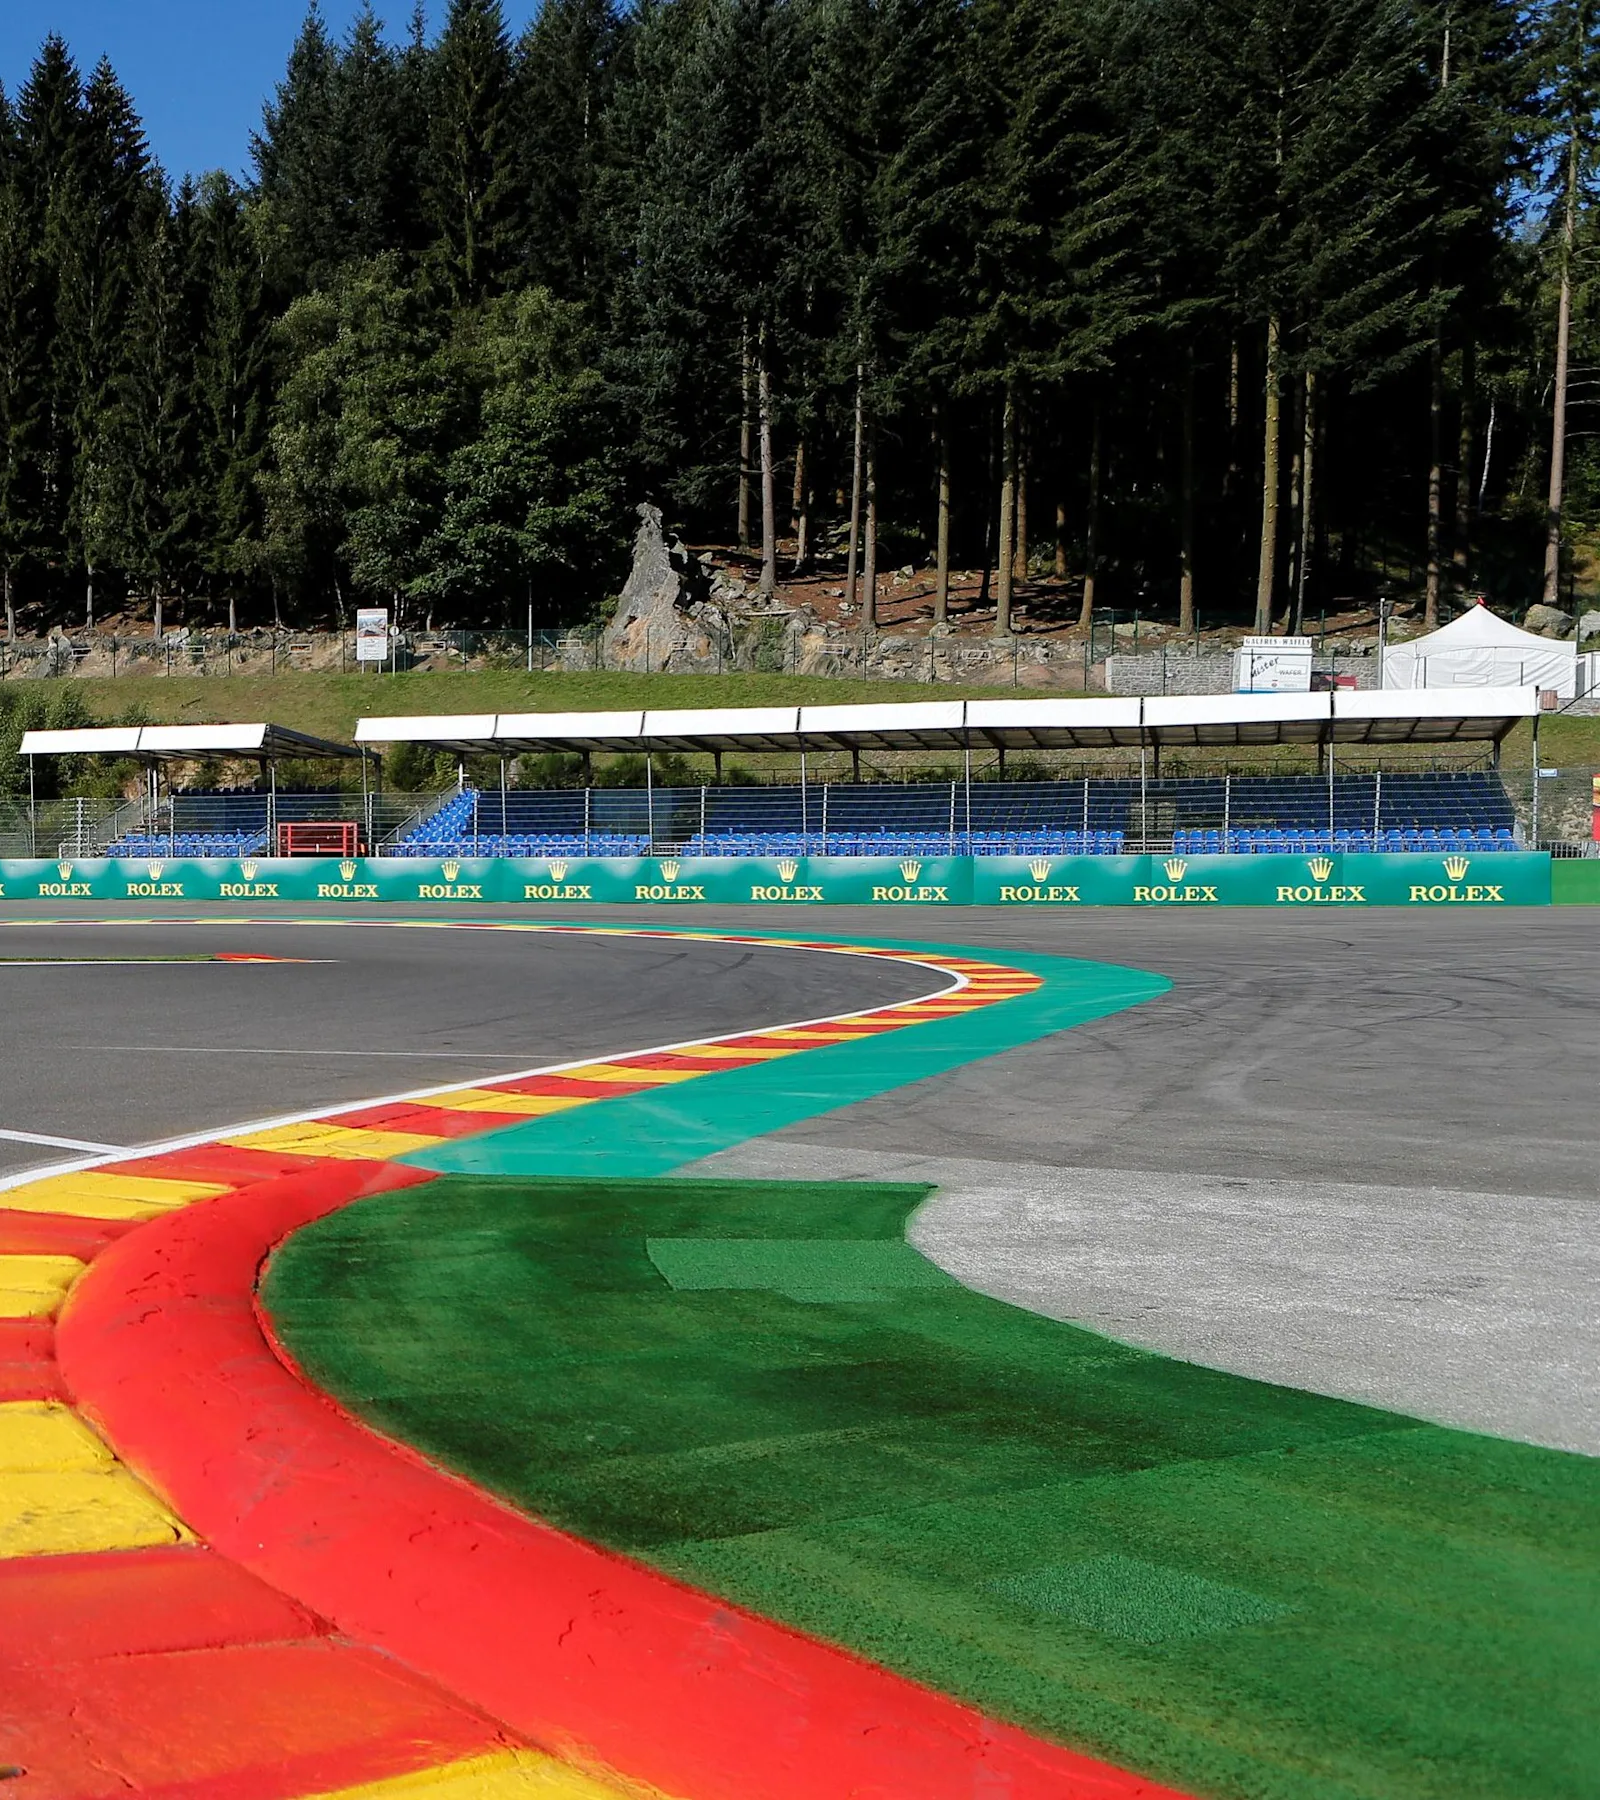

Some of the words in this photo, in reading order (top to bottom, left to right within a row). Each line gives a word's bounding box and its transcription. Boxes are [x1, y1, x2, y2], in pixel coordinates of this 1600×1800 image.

[39, 883, 91, 896] ROLEX
[127, 883, 183, 896] ROLEX
[220, 883, 278, 897] ROLEX
[318, 884, 378, 898] ROLEX
[419, 884, 481, 898] ROLEX
[525, 885, 591, 899] ROLEX
[636, 885, 705, 900] ROLEX
[751, 886, 823, 901] ROLEX
[873, 886, 947, 901] ROLEX
[1001, 886, 1079, 901] ROLEX
[1134, 886, 1217, 902] ROLEX
[1277, 886, 1365, 902] ROLEX
[1410, 885, 1504, 902] ROLEX
